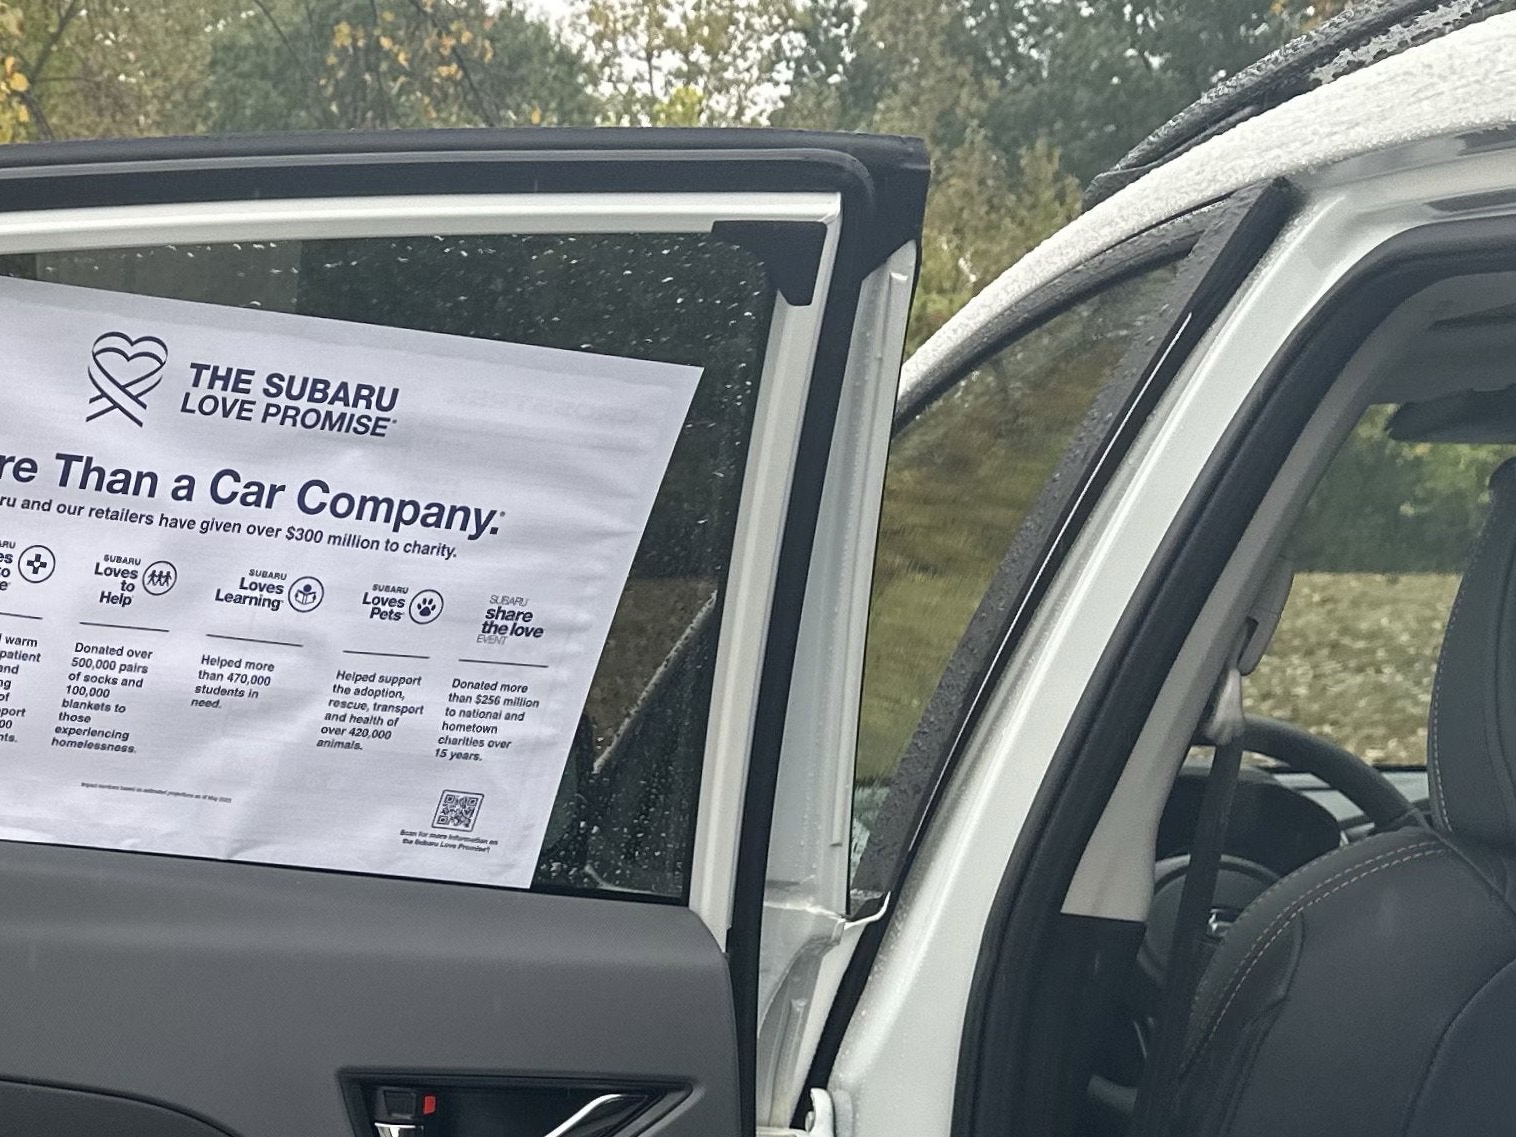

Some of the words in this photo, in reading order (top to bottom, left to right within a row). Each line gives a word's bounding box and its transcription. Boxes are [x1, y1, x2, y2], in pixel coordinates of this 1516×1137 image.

[190, 362, 256, 395] THE
[262, 372, 400, 412] SUBARU
[180, 392, 257, 422] LOVE
[55, 452, 158, 498] Than
[171, 474, 196, 502] a
[210, 468, 286, 509] Car
[20, 498, 54, 513] and
[55, 502, 86, 517] our
[87, 506, 155, 526] retailers
[157, 512, 197, 531] have
[198, 516, 243, 535] given
[245, 523, 283, 539] over
[284, 524, 325, 544] $300
[326, 532, 381, 551] million
[383, 537, 400, 553] to
[402, 539, 458, 562] charity.
[104, 554, 141, 566] SUBARU
[94, 562, 139, 580] Loves
[249, 569, 287, 581] SUBARU
[120, 579, 136, 593] to
[239, 577, 284, 595] Loves
[372, 584, 409, 594] SUBARU
[362, 592, 406, 608] Loves
[485, 605, 534, 623] share
[481, 620, 509, 636] the
[509, 622, 544, 638] love
[5, 635, 38, 648] warm
[74, 642, 125, 657] Donated
[126, 649, 154, 660] over
[71, 656, 117, 671] 500,000
[118, 662, 149, 674] pairs
[201, 654, 243, 670] Helped
[244, 661, 275, 672] more
[68, 671, 83, 682] of
[83, 674, 119, 686] socks
[120, 677, 144, 688] and
[198, 669, 224, 682] than
[226, 672, 272, 687] 470,000
[336, 669, 377, 685] Helped
[377, 675, 422, 687] support
[452, 678, 499, 692] Donated
[499, 683, 529, 694] more
[66, 684, 111, 699] 100,000
[194, 684, 246, 698] students
[247, 688, 259, 699] in
[332, 683, 352, 696] the
[352, 686, 406, 702] adoption,
[61, 697, 112, 712] blankets
[114, 703, 126, 714] to
[190, 699, 222, 709] need.
[328, 699, 370, 713] rescue,
[372, 701, 425, 716] transport
[448, 692, 473, 704] than
[474, 693, 502, 706] $256
[502, 696, 540, 709] million
[58, 711, 92, 724] those
[324, 712, 348, 723] and
[348, 713, 384, 726] health
[386, 717, 400, 727] of
[445, 706, 457, 717] to
[458, 708, 503, 720] national
[504, 711, 526, 722] and
[55, 726, 130, 742] experiencing
[320, 726, 347, 736] over
[348, 727, 392, 740] 420,000
[441, 720, 498, 735] hometown
[51, 736, 137, 754] homelessness.
[316, 738, 363, 751] animals.
[437, 735, 485, 748] charities
[487, 740, 512, 749] over
[435, 748, 449, 758] 15
[447, 751, 483, 762] years.
